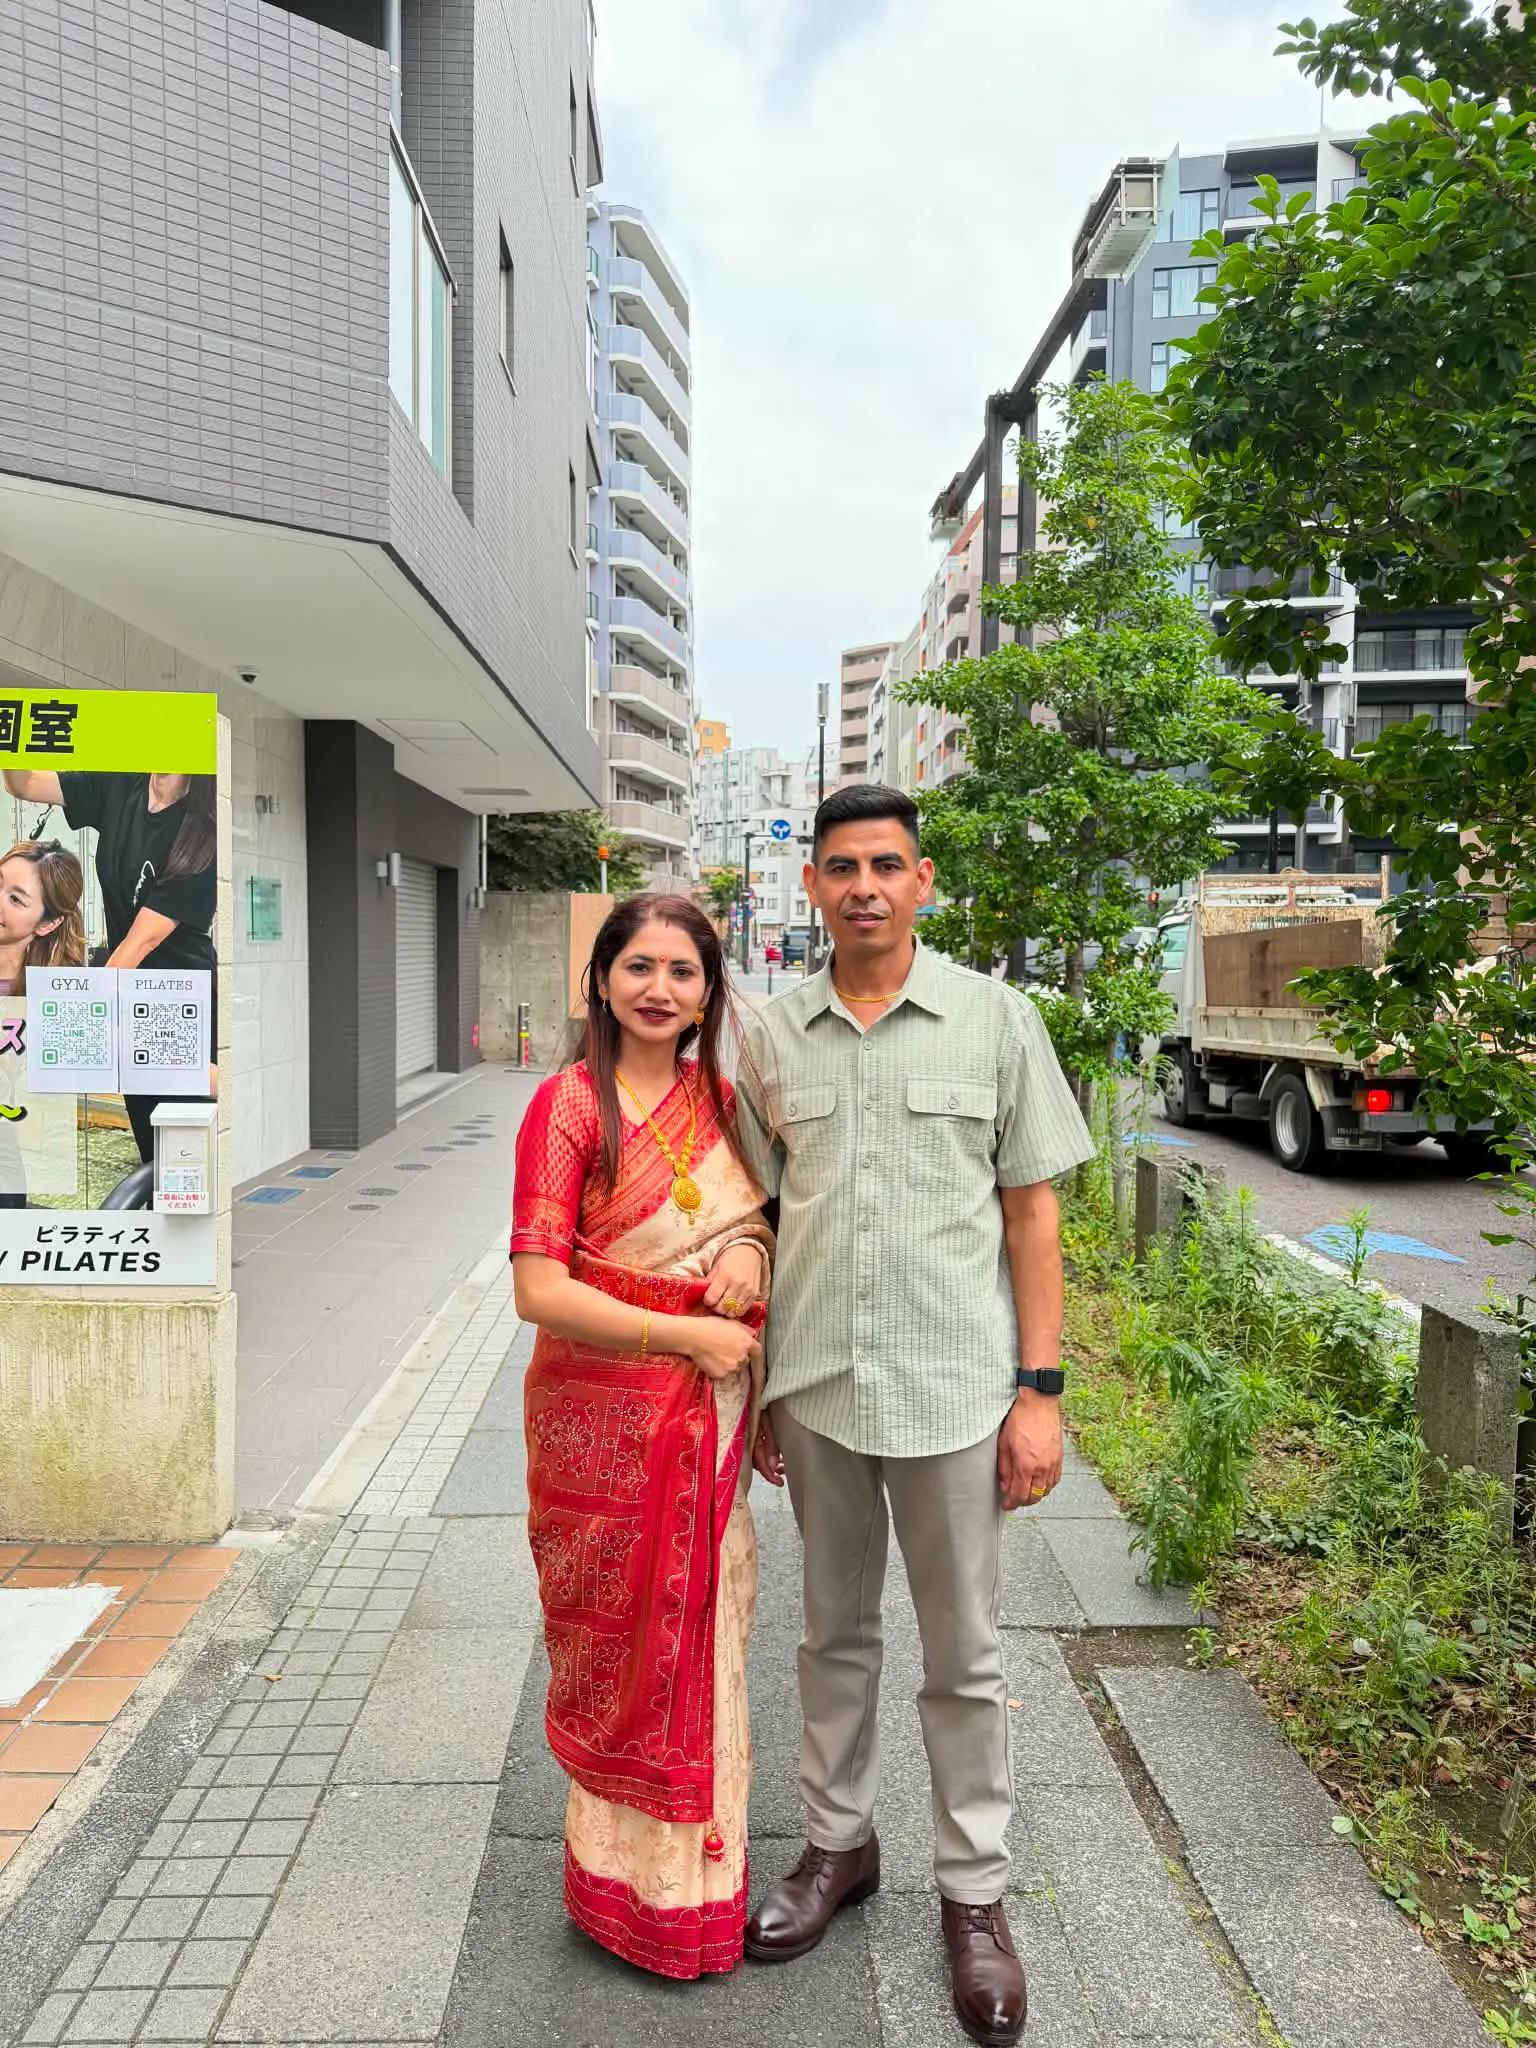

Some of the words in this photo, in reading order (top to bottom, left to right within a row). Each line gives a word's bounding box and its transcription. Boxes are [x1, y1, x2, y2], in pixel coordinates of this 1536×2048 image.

[51, 978, 90, 991] GYM
[135, 979, 193, 991] PILATES
[63, 1029, 86, 1038] LINE
[154, 1030, 177, 1039] LINE
[36, 1224, 151, 1245] ピラティス
[20, 1250, 162, 1273] PILATES
